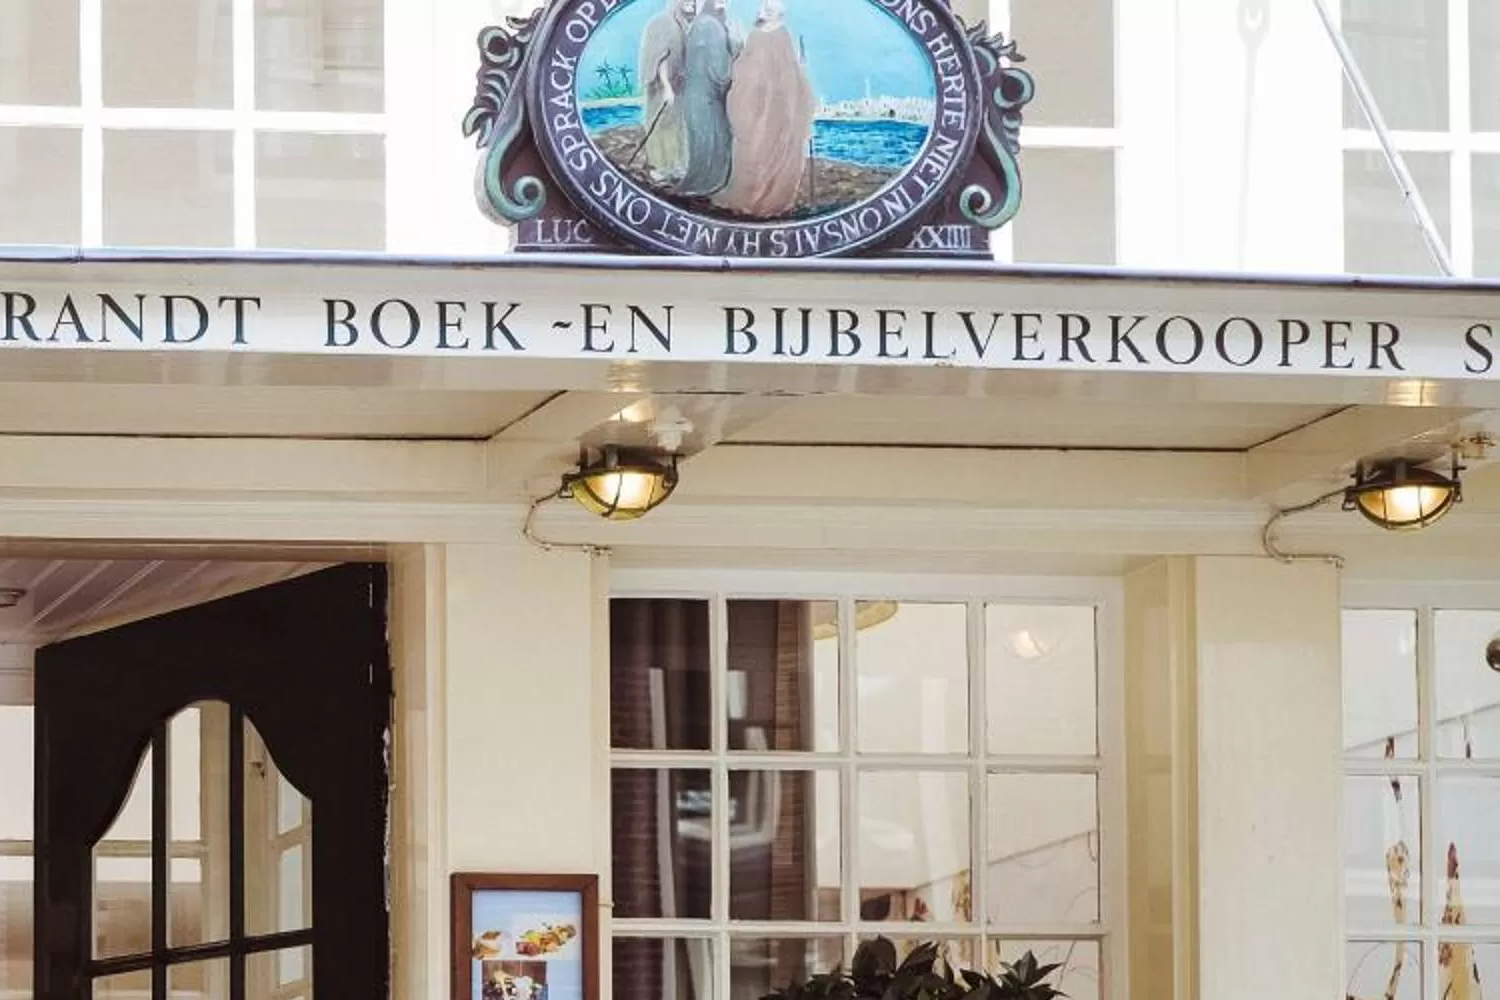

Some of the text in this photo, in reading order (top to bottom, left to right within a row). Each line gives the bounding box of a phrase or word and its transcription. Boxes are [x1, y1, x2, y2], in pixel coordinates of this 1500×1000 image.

[550, 49, 598, 172] SPRACK
[913, 130, 958, 198] NIET
[589, 170, 650, 225] ONS
[881, 187, 914, 219] IN
[534, 219, 592, 243] LUC
[652, 211, 721, 249] MET
[723, 228, 762, 256] HY
[322, 298, 526, 351] BOEK
[722, 306, 1407, 371] BIJBELVERKOOPER
